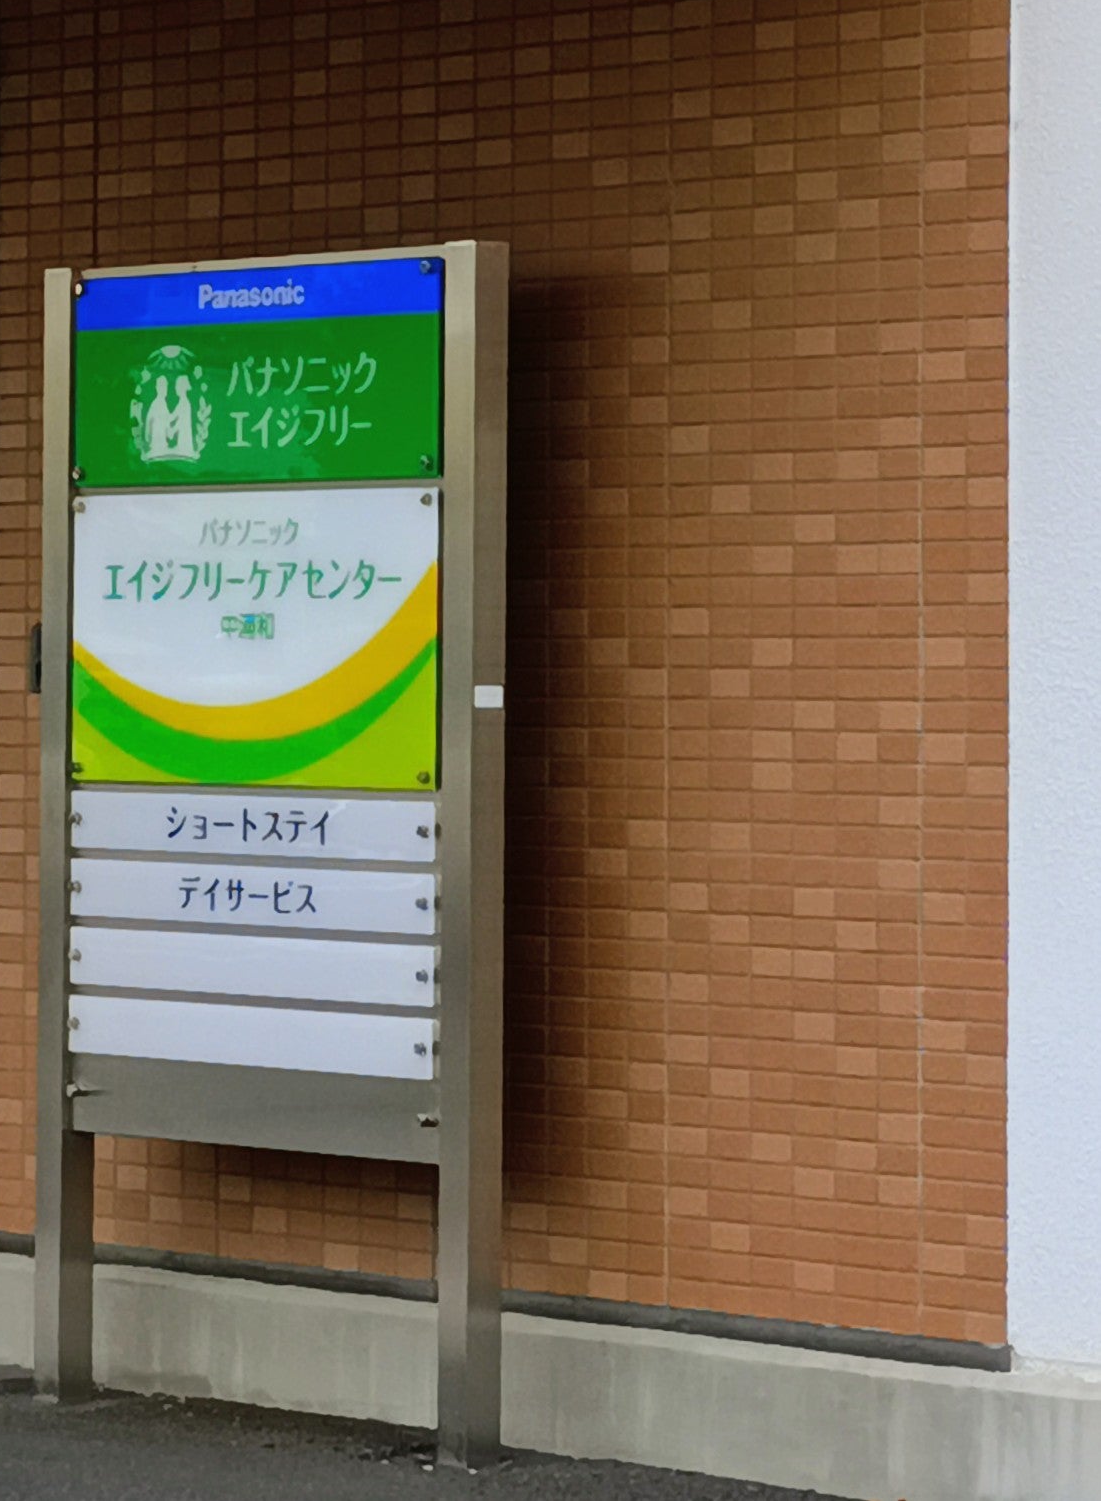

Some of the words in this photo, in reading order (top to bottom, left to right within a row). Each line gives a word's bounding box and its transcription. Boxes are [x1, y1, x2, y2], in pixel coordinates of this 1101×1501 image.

[198, 278, 305, 310] Panasonic
[226, 351, 377, 397] パナソニック
[226, 404, 372, 449] エイジフリー
[199, 517, 299, 546] パナソニック
[102, 559, 402, 602] エイジフリーケアセンター
[166, 806, 329, 846] ショートステイ
[178, 876, 317, 914] デイサービス
